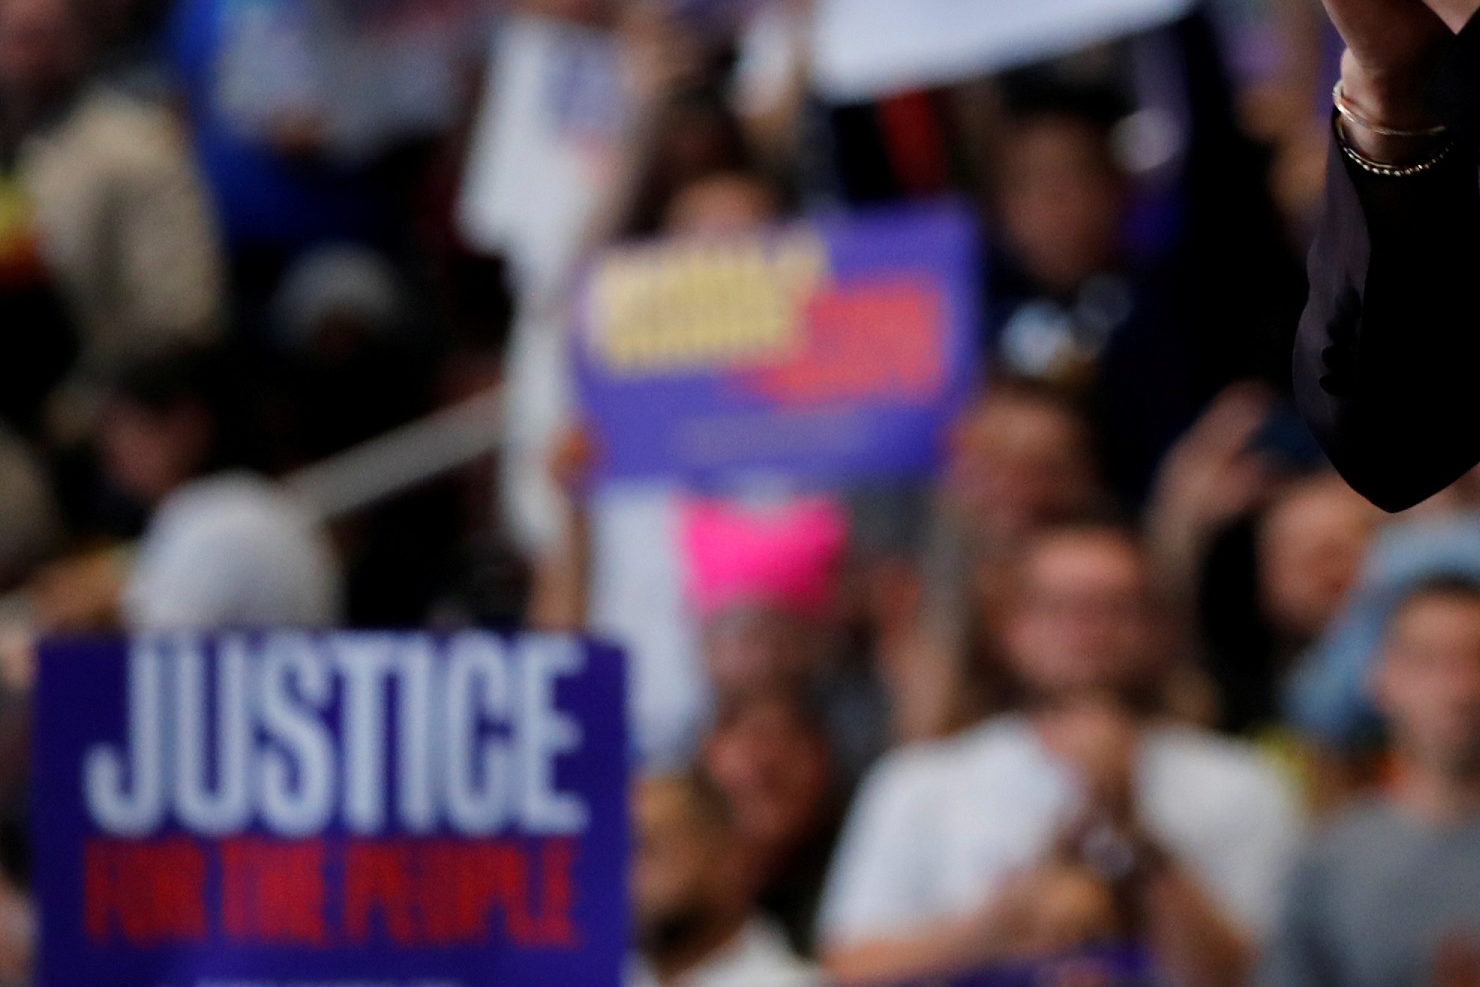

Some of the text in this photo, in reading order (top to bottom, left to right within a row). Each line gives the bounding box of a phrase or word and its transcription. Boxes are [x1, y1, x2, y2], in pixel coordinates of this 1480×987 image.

[83, 632, 589, 837] JUSTICE
[83, 835, 580, 948] FOR THE PEOPLE
